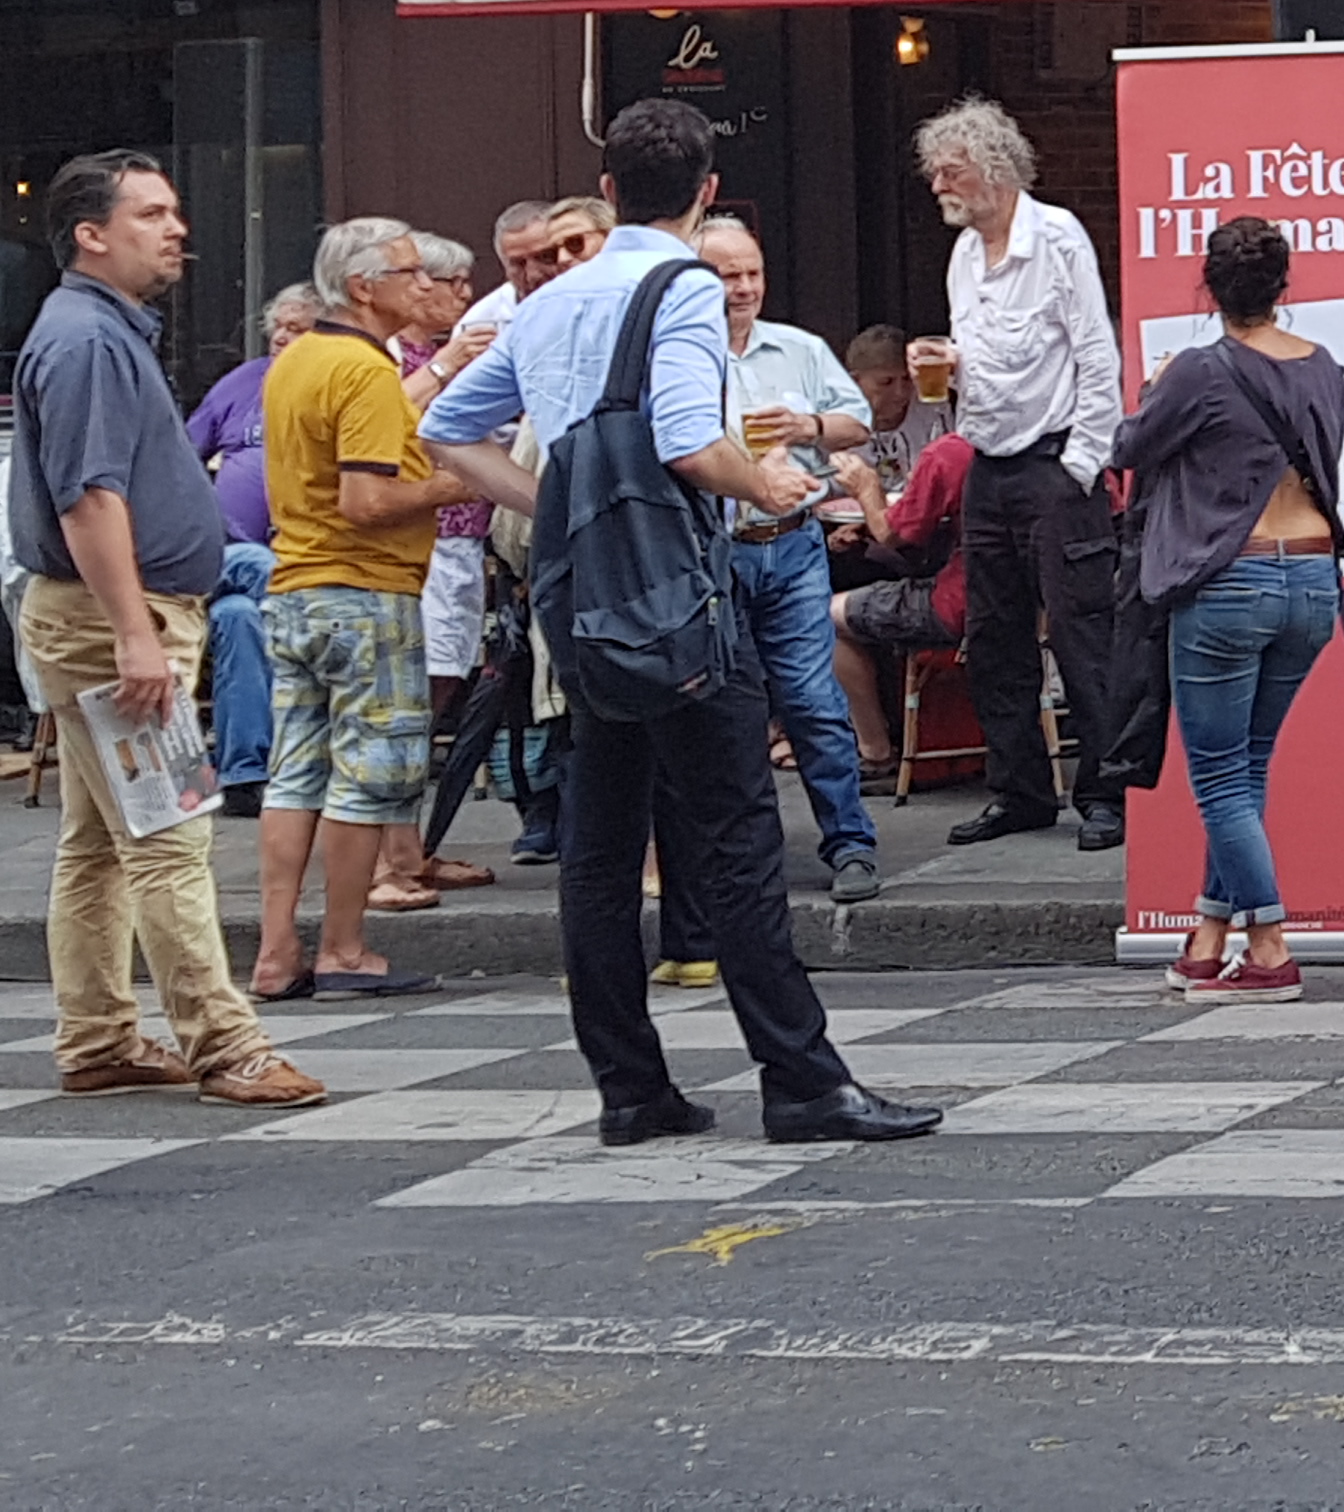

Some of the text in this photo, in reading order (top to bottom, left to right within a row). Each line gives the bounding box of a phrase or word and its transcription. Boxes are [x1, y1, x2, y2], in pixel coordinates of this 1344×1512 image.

[667, 24, 719, 69] la
[1167, 152, 1235, 202] La
[1138, 910, 1204, 929] l'Huma
